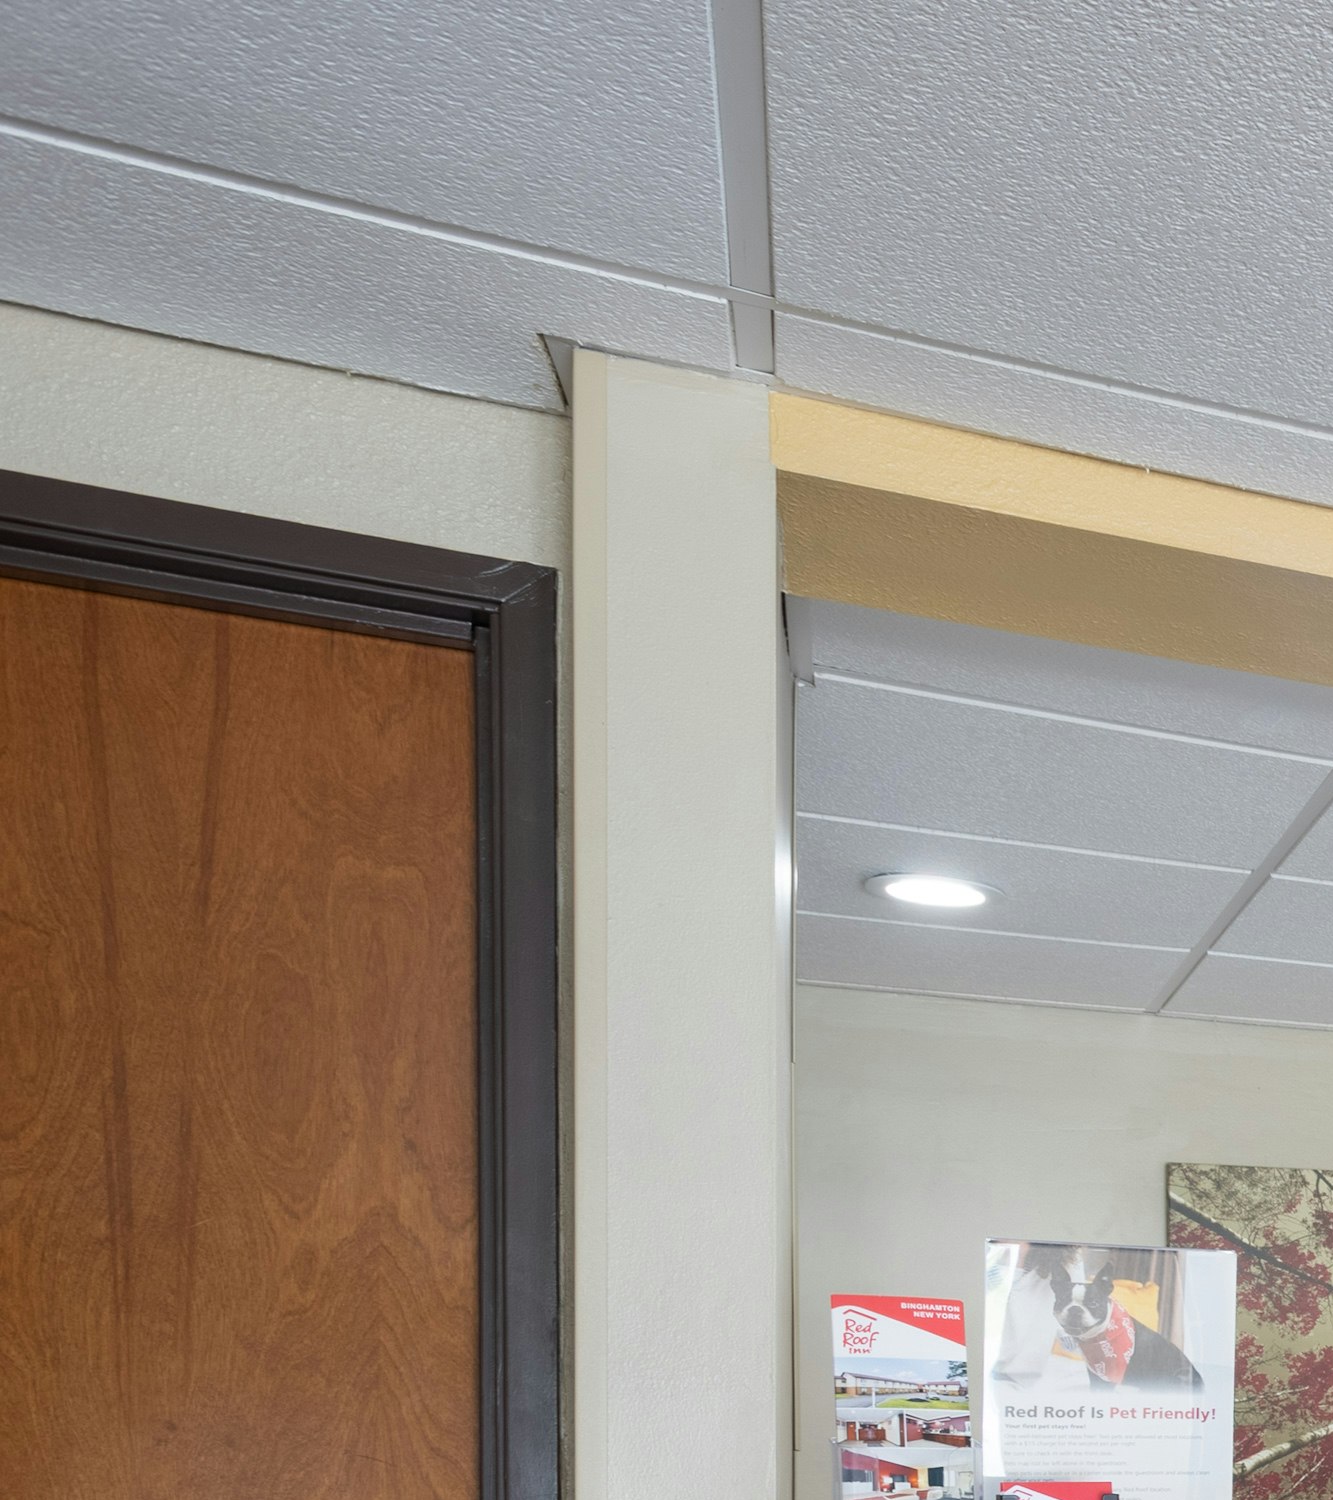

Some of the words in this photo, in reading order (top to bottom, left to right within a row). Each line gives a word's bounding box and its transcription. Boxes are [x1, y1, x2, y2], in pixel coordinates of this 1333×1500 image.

[900, 1302, 960, 1312] BINGHAMTON
[935, 1312, 961, 1320] YORK
[845, 1318, 872, 1333] Red
[842, 1331, 879, 1348] Roof
[1004, 1405, 1038, 1418] Red
[1044, 1406, 1085, 1418] Roof
[1091, 1407, 1104, 1419] Is
[1110, 1407, 1137, 1419] Pet
[1142, 1407, 1216, 1423] Friendly!
